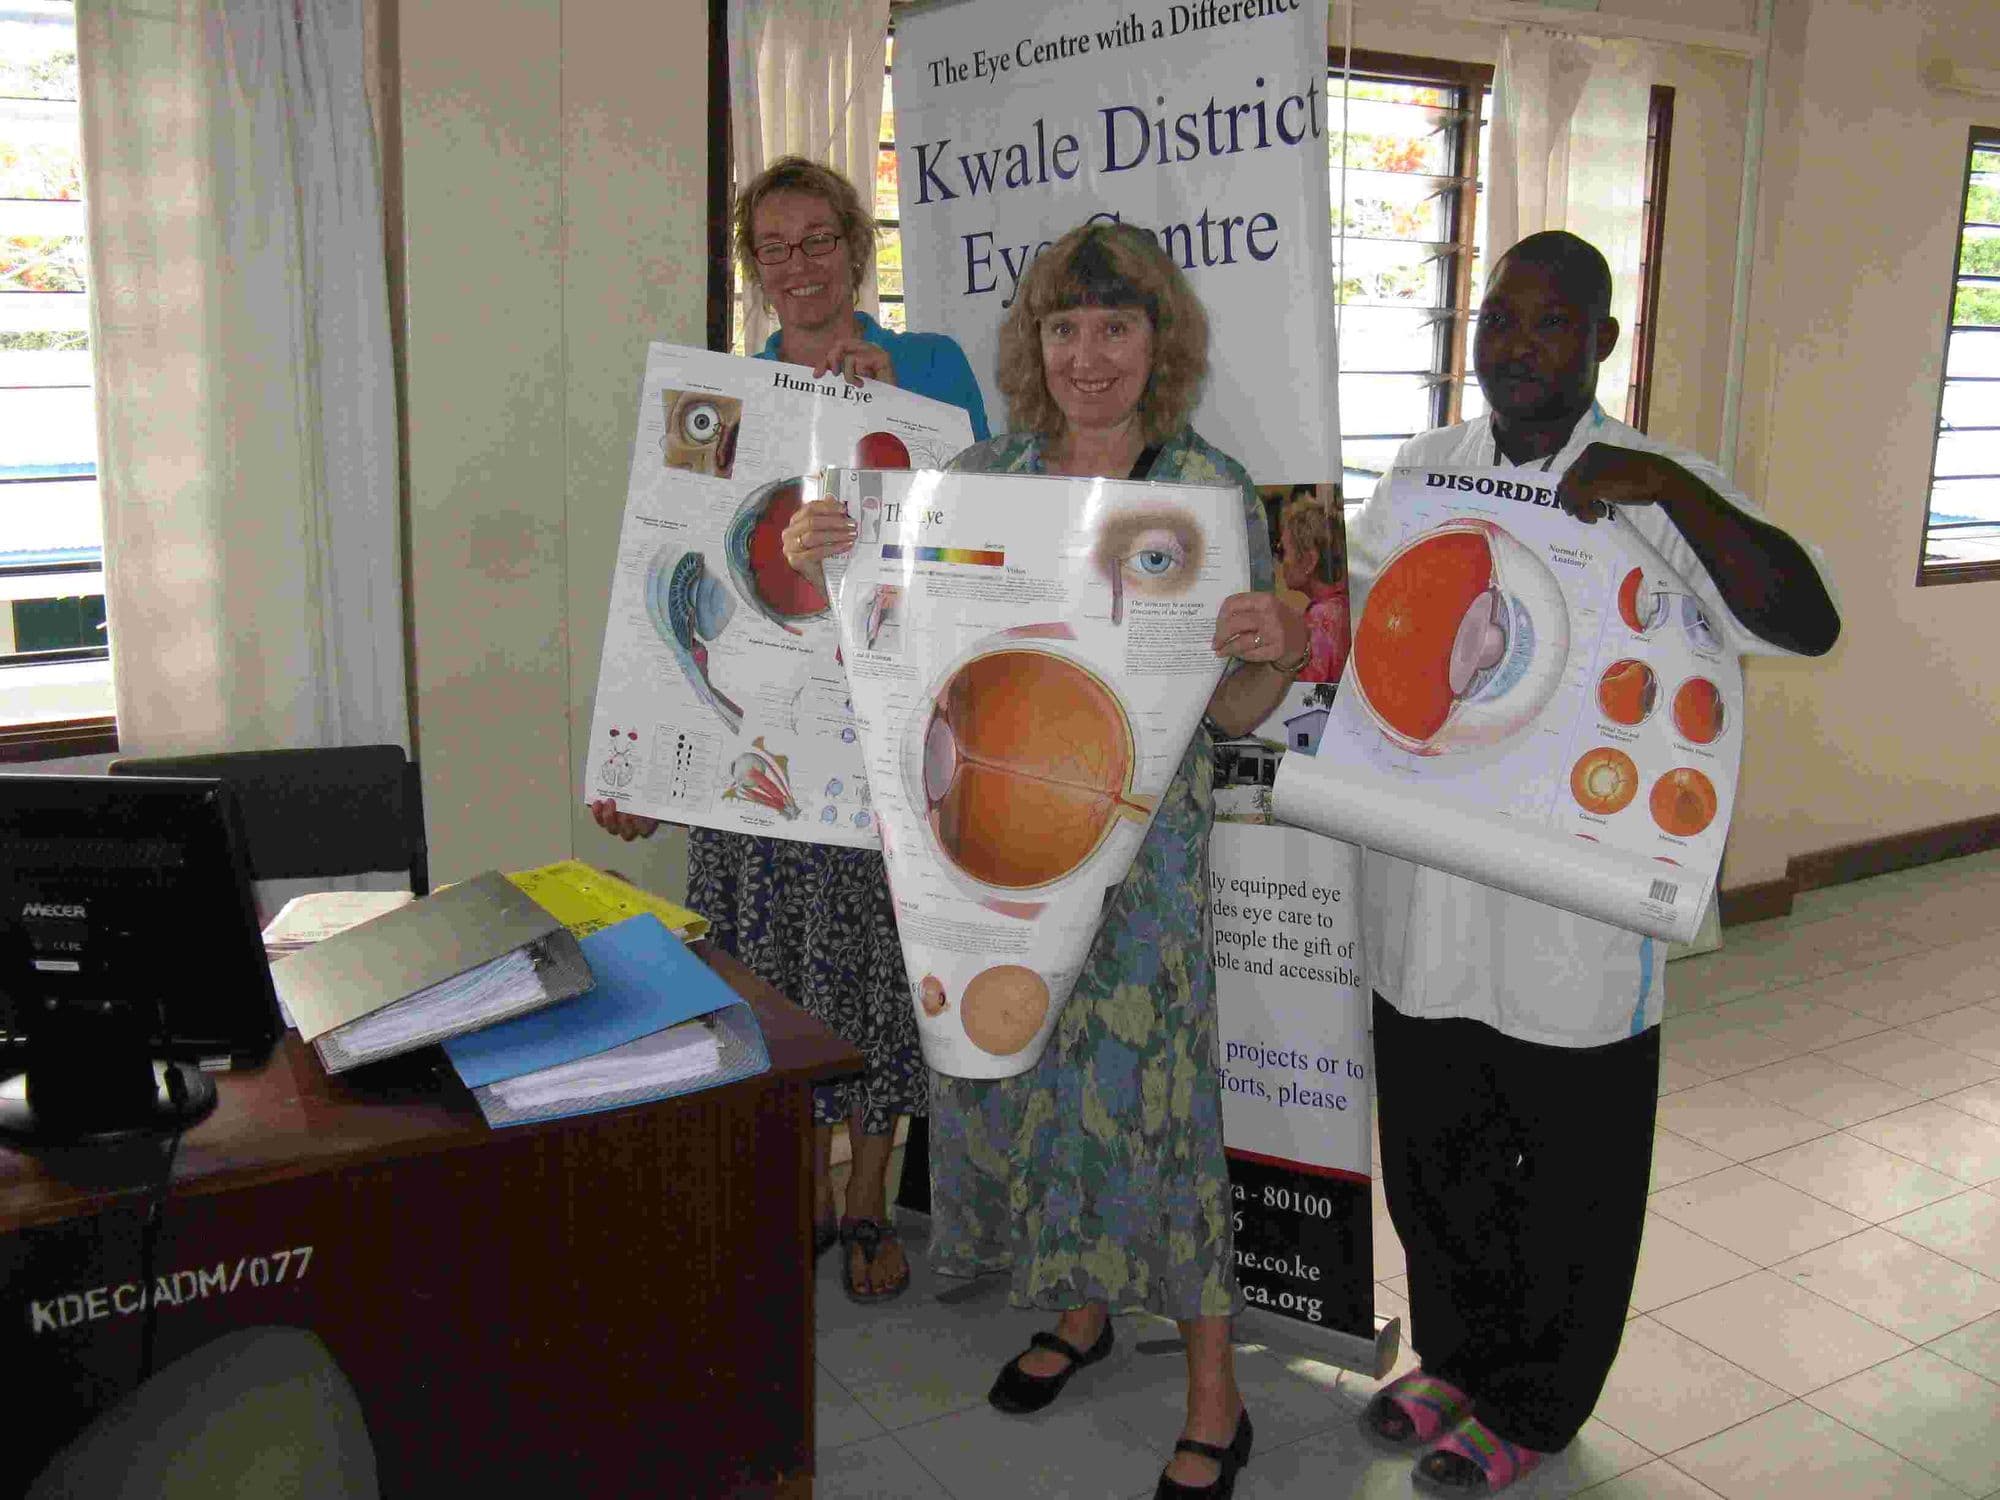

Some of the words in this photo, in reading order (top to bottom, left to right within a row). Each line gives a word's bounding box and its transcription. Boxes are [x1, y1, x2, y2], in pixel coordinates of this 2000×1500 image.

[928, 55, 968, 87] The
[973, 50, 1011, 84] Eye
[1015, 34, 1090, 68] Centre
[1097, 18, 1146, 50] with
[1151, 21, 1164, 40] a
[912, 118, 1080, 205] Kwale
[1098, 77, 1321, 173] District
[961, 231, 1052, 309] Ey
[773, 372, 836, 397] Human
[841, 384, 873, 406] Eye
[1426, 473, 1562, 510] DISORDE
[917, 509, 944, 530] ye
[1548, 544, 1578, 557] Normal
[1579, 550, 1594, 562] Eye
[1552, 554, 1588, 569] Anatomy
[1211, 871, 1227, 894] ly
[1230, 876, 1307, 901] equipped
[1312, 886, 1341, 905] eye
[1213, 898, 1238, 919] des
[1243, 905, 1272, 924] eye
[1278, 908, 1312, 926] care
[1317, 911, 1334, 929] to
[1215, 929, 1267, 951] people
[1272, 930, 1299, 951] the
[1303, 936, 1332, 960] gift
[1337, 942, 1355, 961] of
[1244, 957, 1273, 976] and
[1279, 961, 1361, 988] accessible
[1226, 1040, 1308, 1071] projects
[1316, 1054, 1339, 1075] or
[1346, 1057, 1364, 1080] to
[1217, 1067, 1272, 1102] forts,
[1278, 1082, 1348, 1112] please
[1263, 1186, 1332, 1219] 80100
[1232, 1210, 1244, 1232] 6
[1235, 1249, 1321, 1282] ne.co.ke
[1242, 1283, 1324, 1322] ca.org
